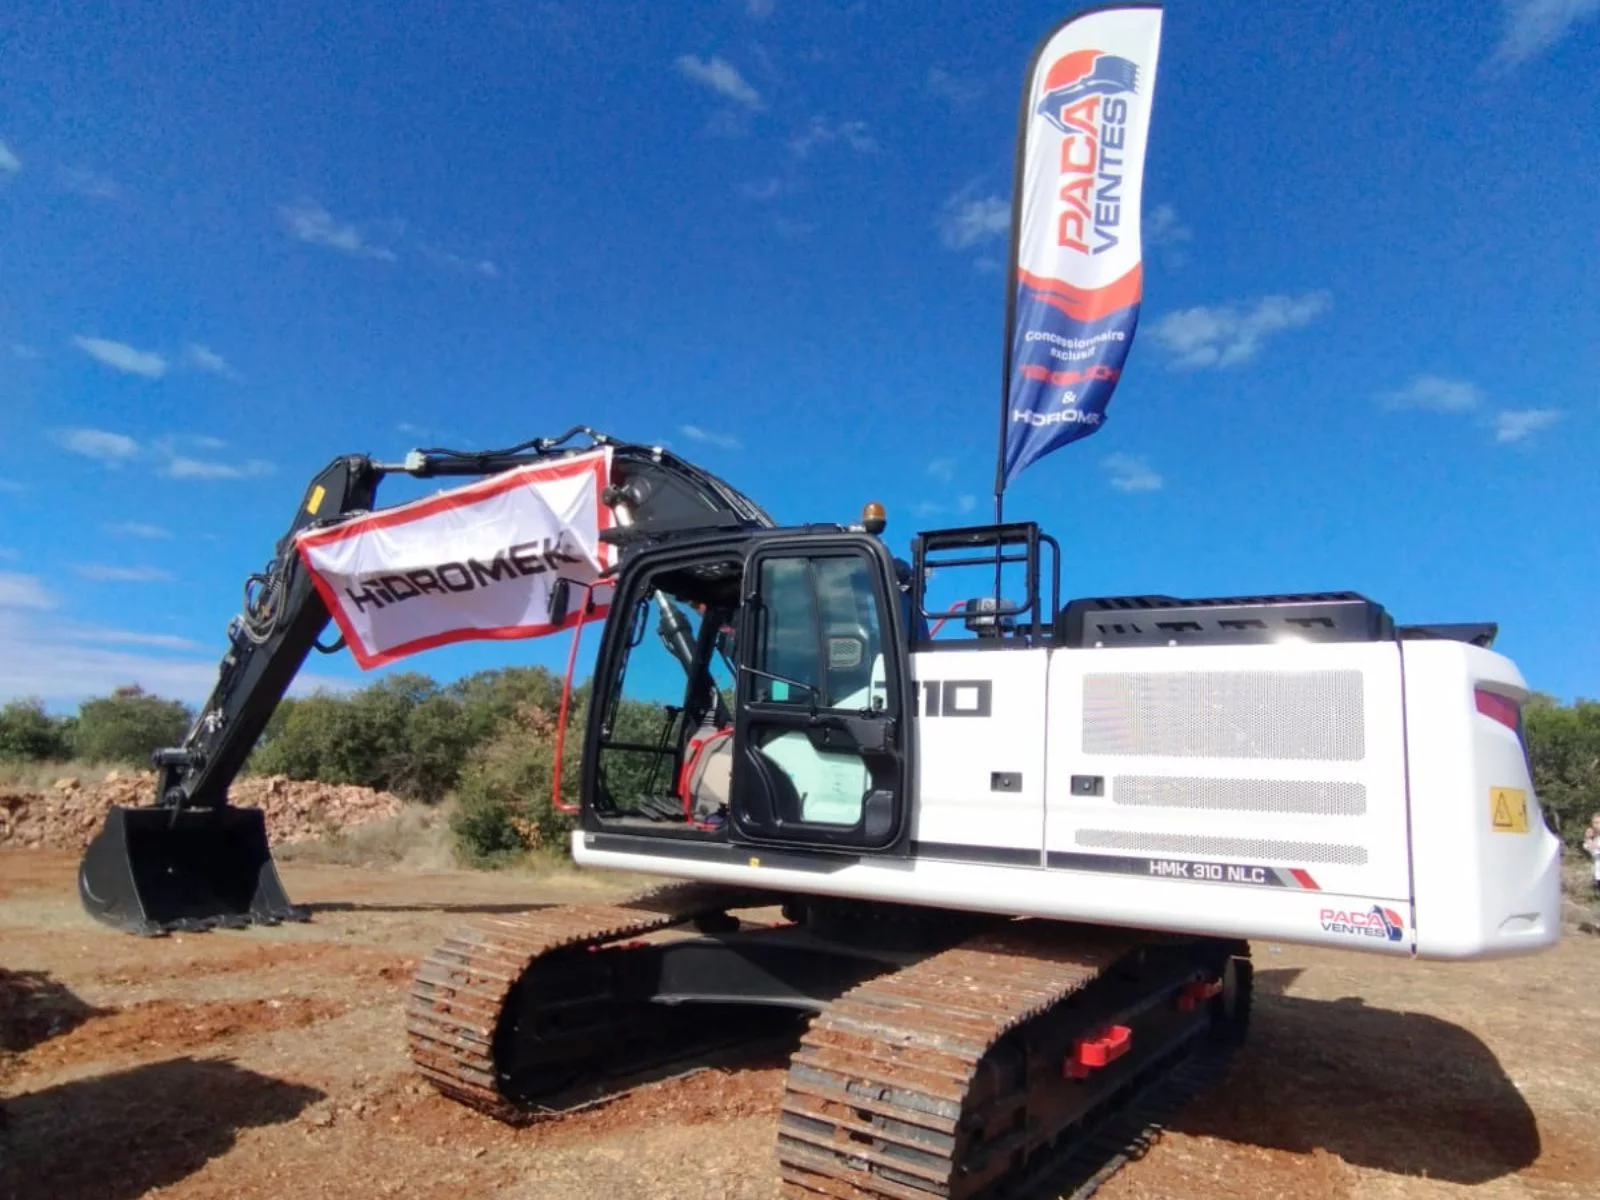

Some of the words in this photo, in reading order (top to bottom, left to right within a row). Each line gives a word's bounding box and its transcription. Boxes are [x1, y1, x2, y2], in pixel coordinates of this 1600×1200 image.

[1057, 95, 1101, 256] PACA
[1092, 97, 1128, 255] VENTES
[1024, 330, 1126, 349] Concessionnaire
[1050, 346, 1096, 361] exclusif
[1062, 391, 1076, 404] &
[1149, 859, 1188, 877] HMK
[1193, 863, 1222, 880] 310
[1227, 865, 1265, 883] NLC
[1320, 908, 1385, 928] PACA
[1321, 922, 1386, 938] VENTES
